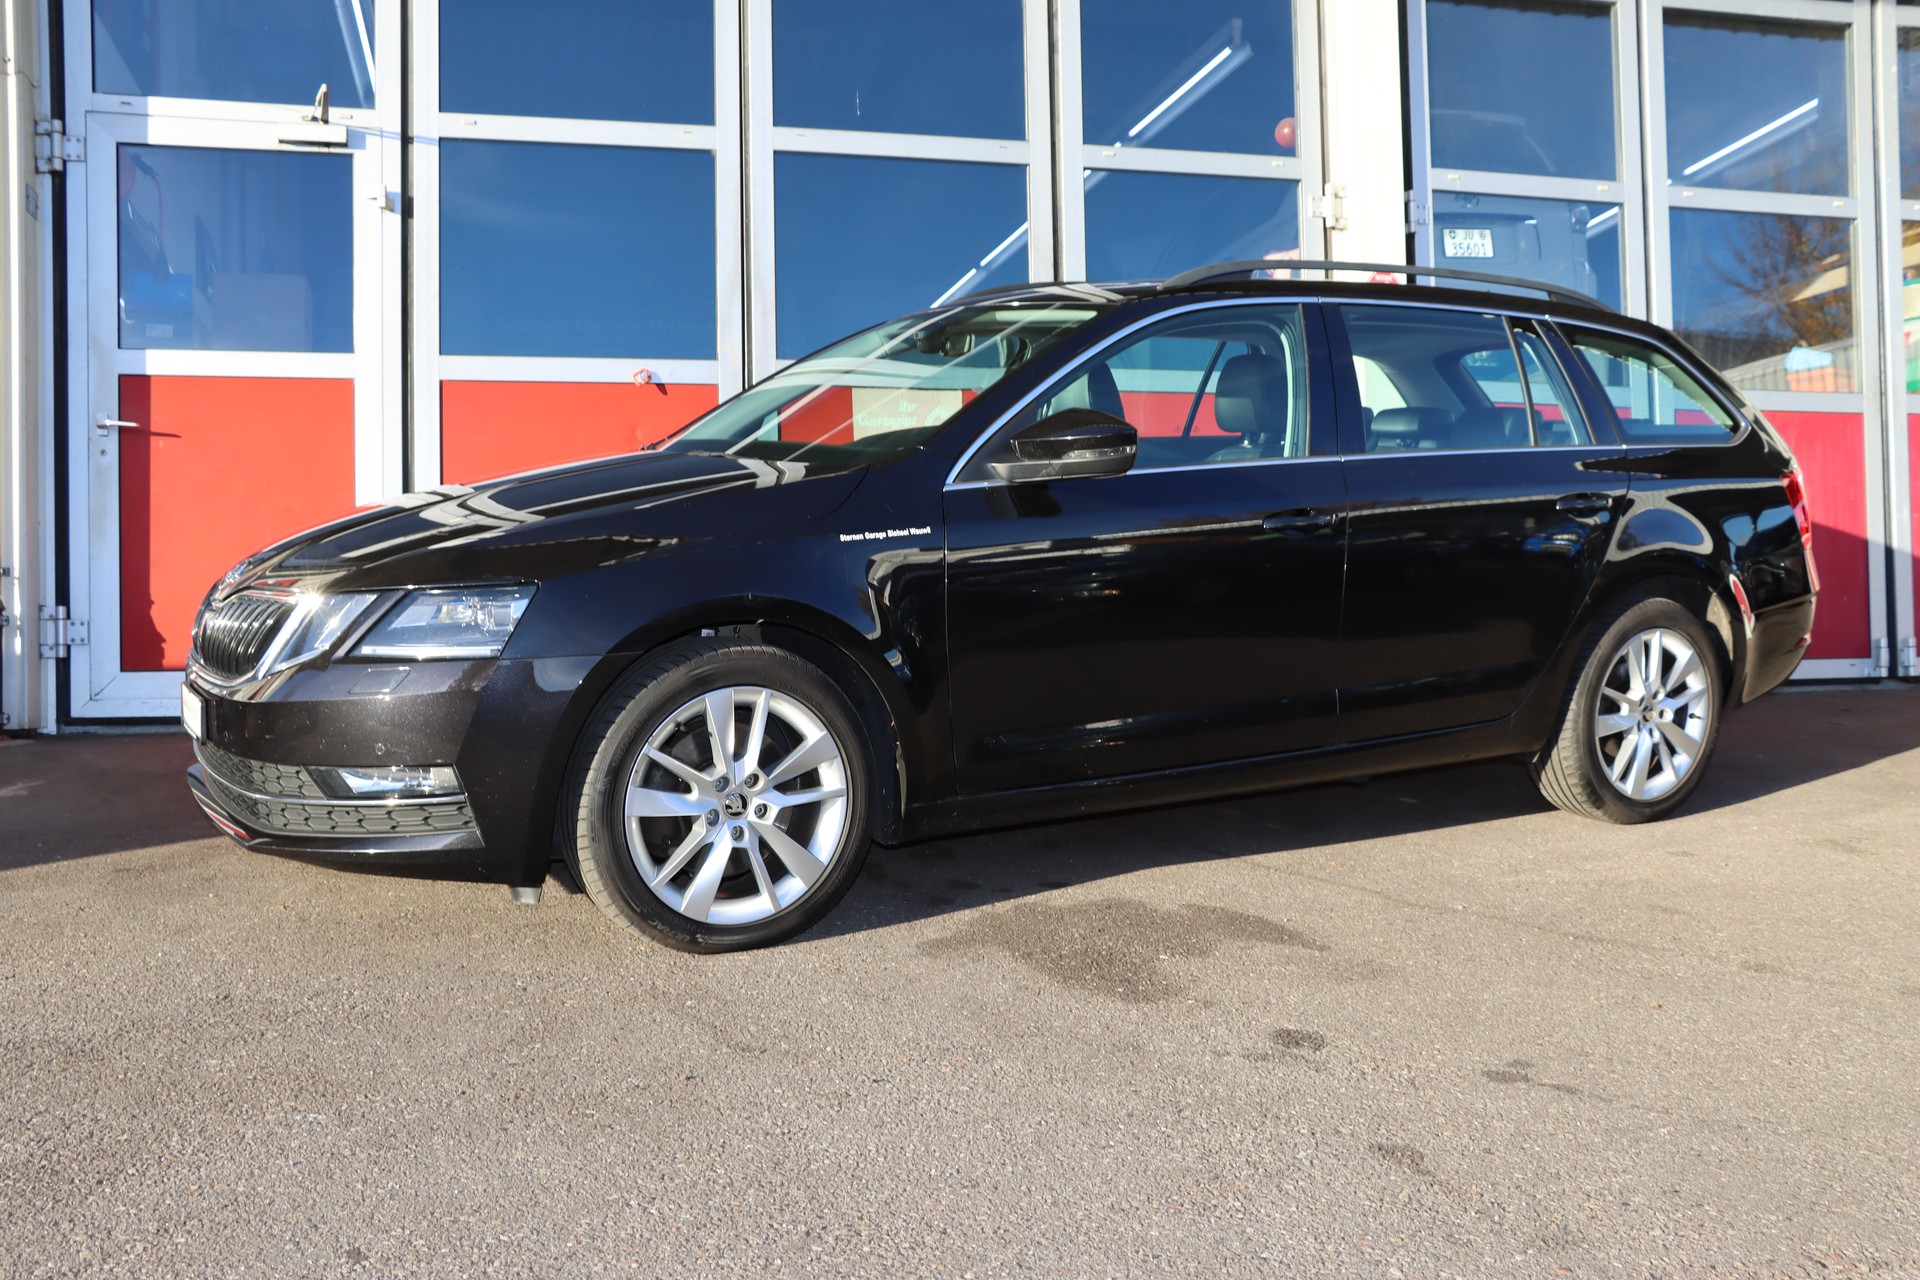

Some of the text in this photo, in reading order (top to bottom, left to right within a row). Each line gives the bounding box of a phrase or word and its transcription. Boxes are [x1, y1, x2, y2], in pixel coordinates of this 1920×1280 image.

[1463, 230, 1474, 240] JU
[1452, 242, 1487, 255] 35601
[899, 400, 917, 412] Ihr
[864, 531, 887, 540] Garage
